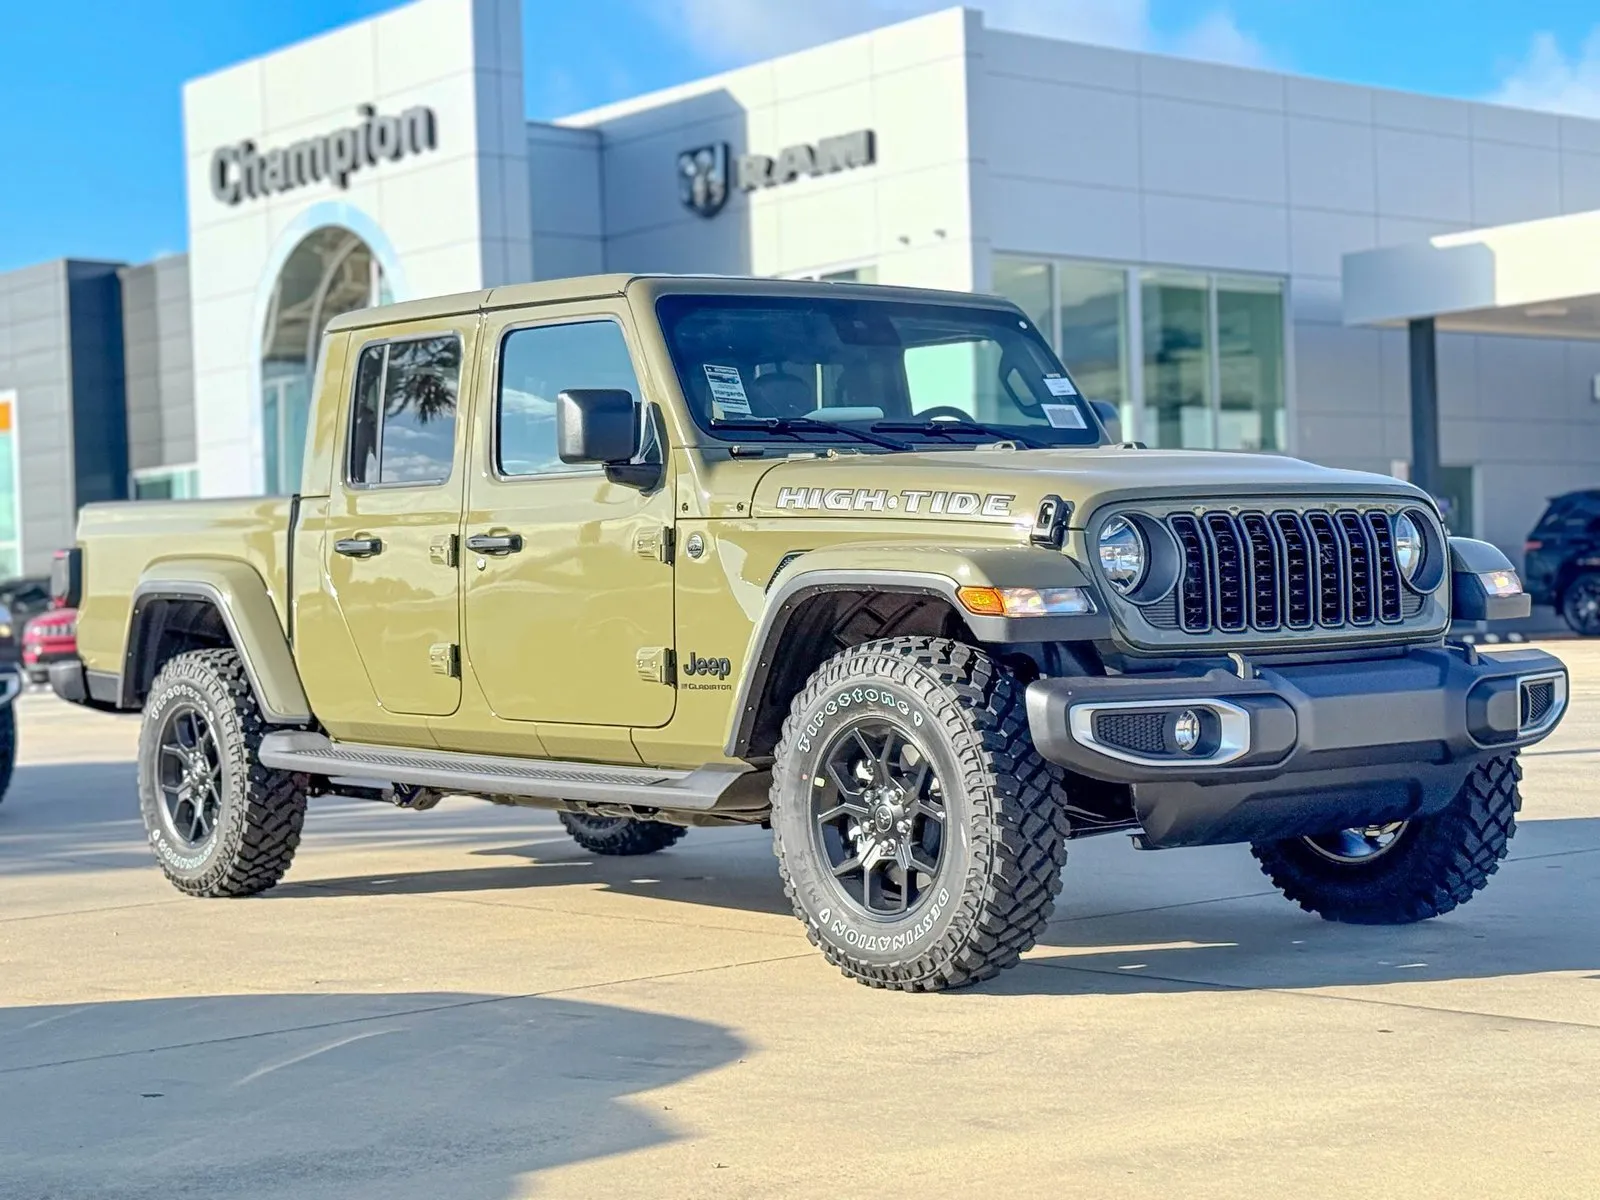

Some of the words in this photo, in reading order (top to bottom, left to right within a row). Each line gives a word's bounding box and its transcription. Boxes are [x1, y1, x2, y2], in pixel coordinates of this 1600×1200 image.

[210, 103, 437, 206] Champion
[737, 128, 877, 193] RAM
[776, 487, 889, 511] HIGH
[900, 490, 1016, 516] TIDE
[683, 651, 731, 681] Jeep
[798, 688, 909, 752] Firestone
[832, 888, 949, 950] DESTINATION
